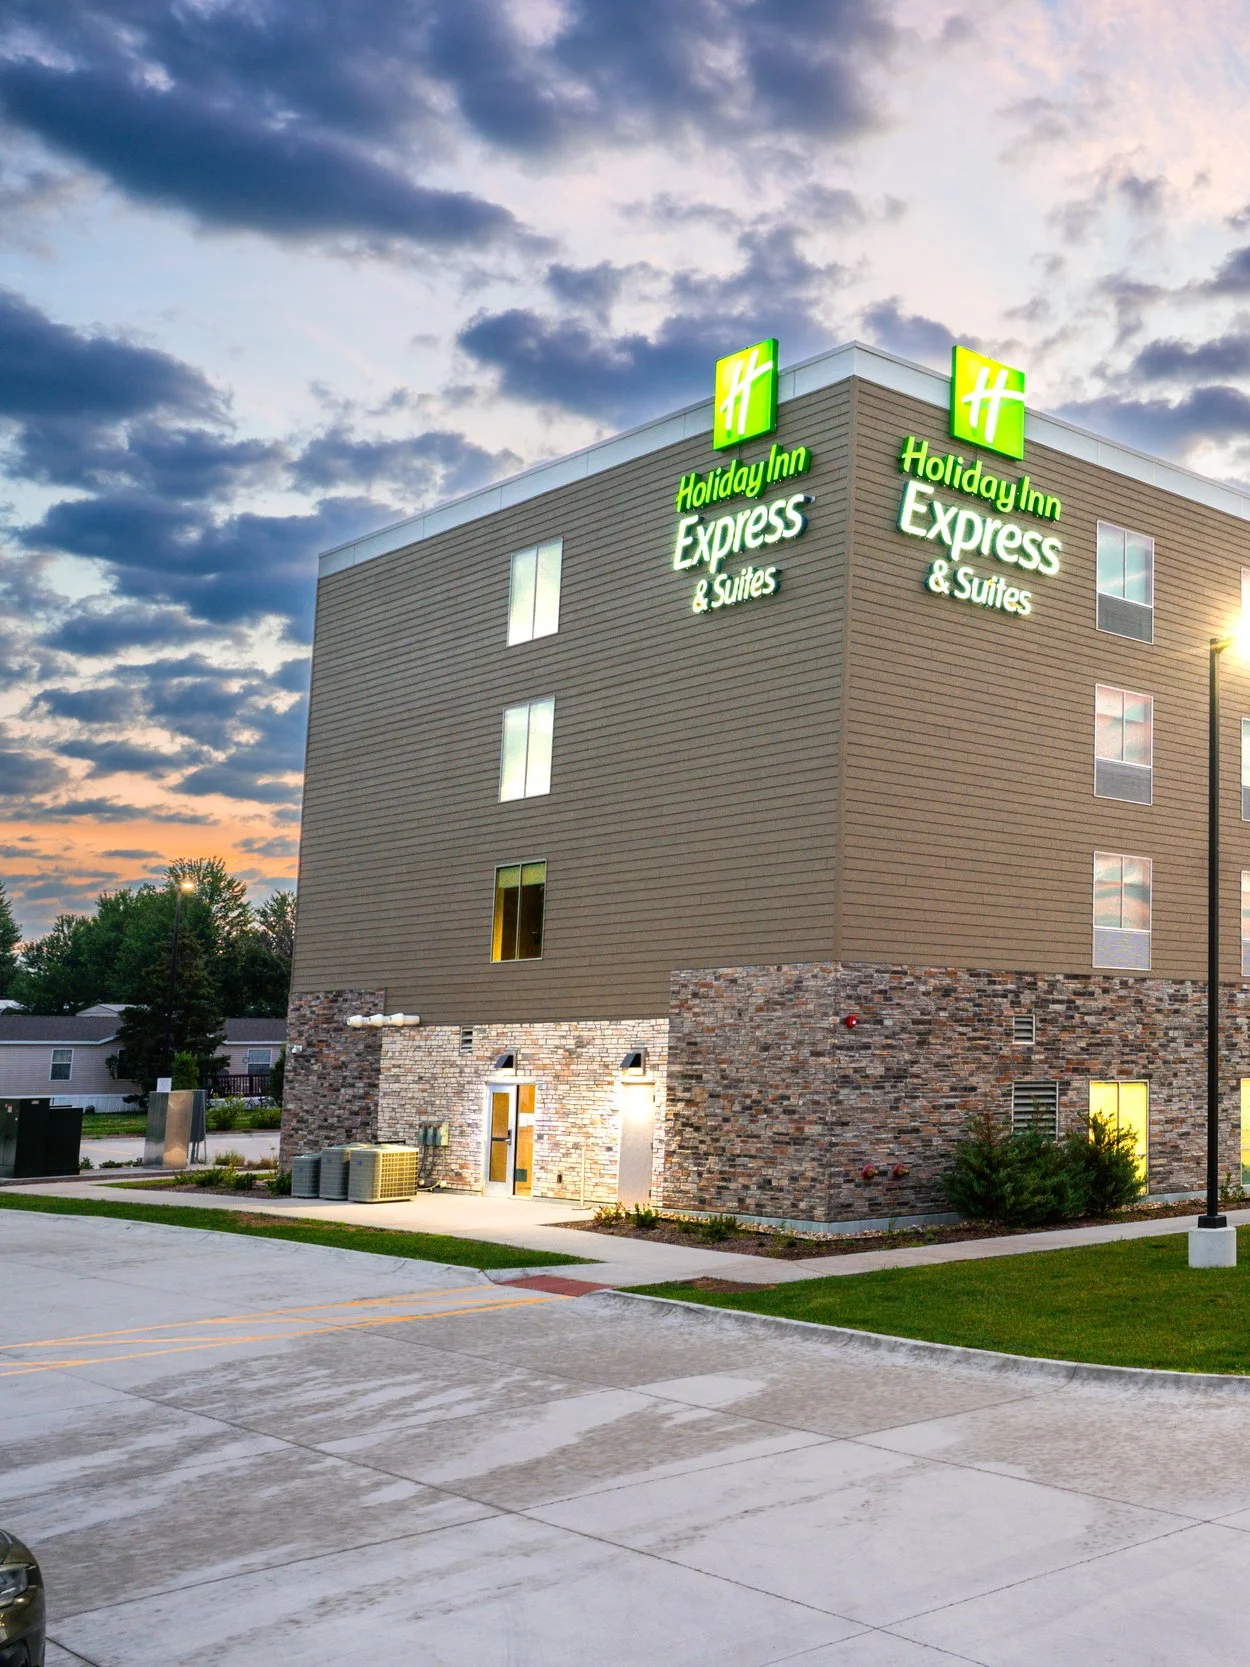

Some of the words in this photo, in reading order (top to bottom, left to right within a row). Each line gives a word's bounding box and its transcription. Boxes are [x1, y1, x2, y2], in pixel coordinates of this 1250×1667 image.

[675, 458, 766, 513] Holiday
[766, 443, 811, 483] Inn
[899, 436, 1017, 513] Holiday
[1018, 475, 1063, 521] Inn
[673, 493, 806, 574] Express
[898, 479, 1063, 576] Express
[692, 579, 709, 613] &
[711, 565, 778, 609] Suites
[927, 558, 949, 595] &
[952, 565, 1032, 616] Suites
